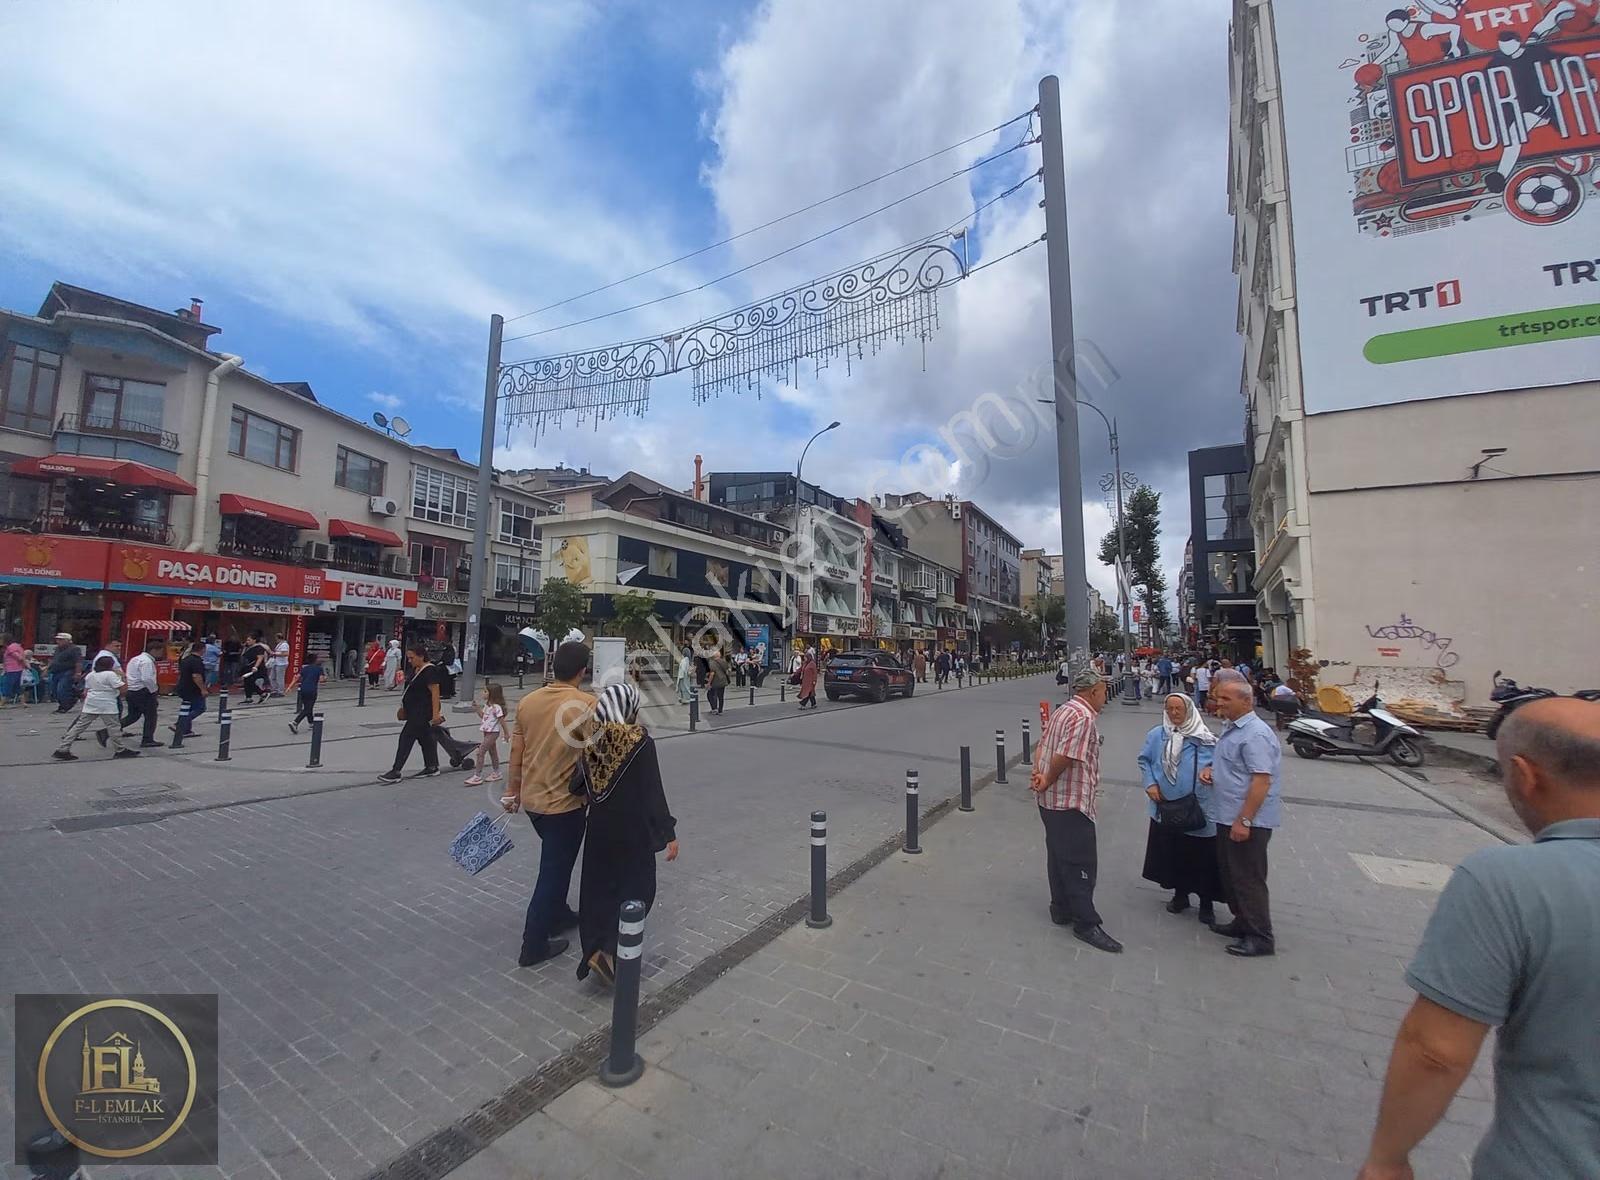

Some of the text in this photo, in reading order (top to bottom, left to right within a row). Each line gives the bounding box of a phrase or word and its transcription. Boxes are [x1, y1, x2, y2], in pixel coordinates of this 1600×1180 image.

[1465, 3, 1532, 32] TRT
[1405, 65, 1528, 163] SPOR
[1543, 258, 1600, 287] TR
[157, 560, 278, 588] PAŞA DÖNER
[303, 585, 321, 595] BUT
[345, 581, 402, 601] ECZANE
